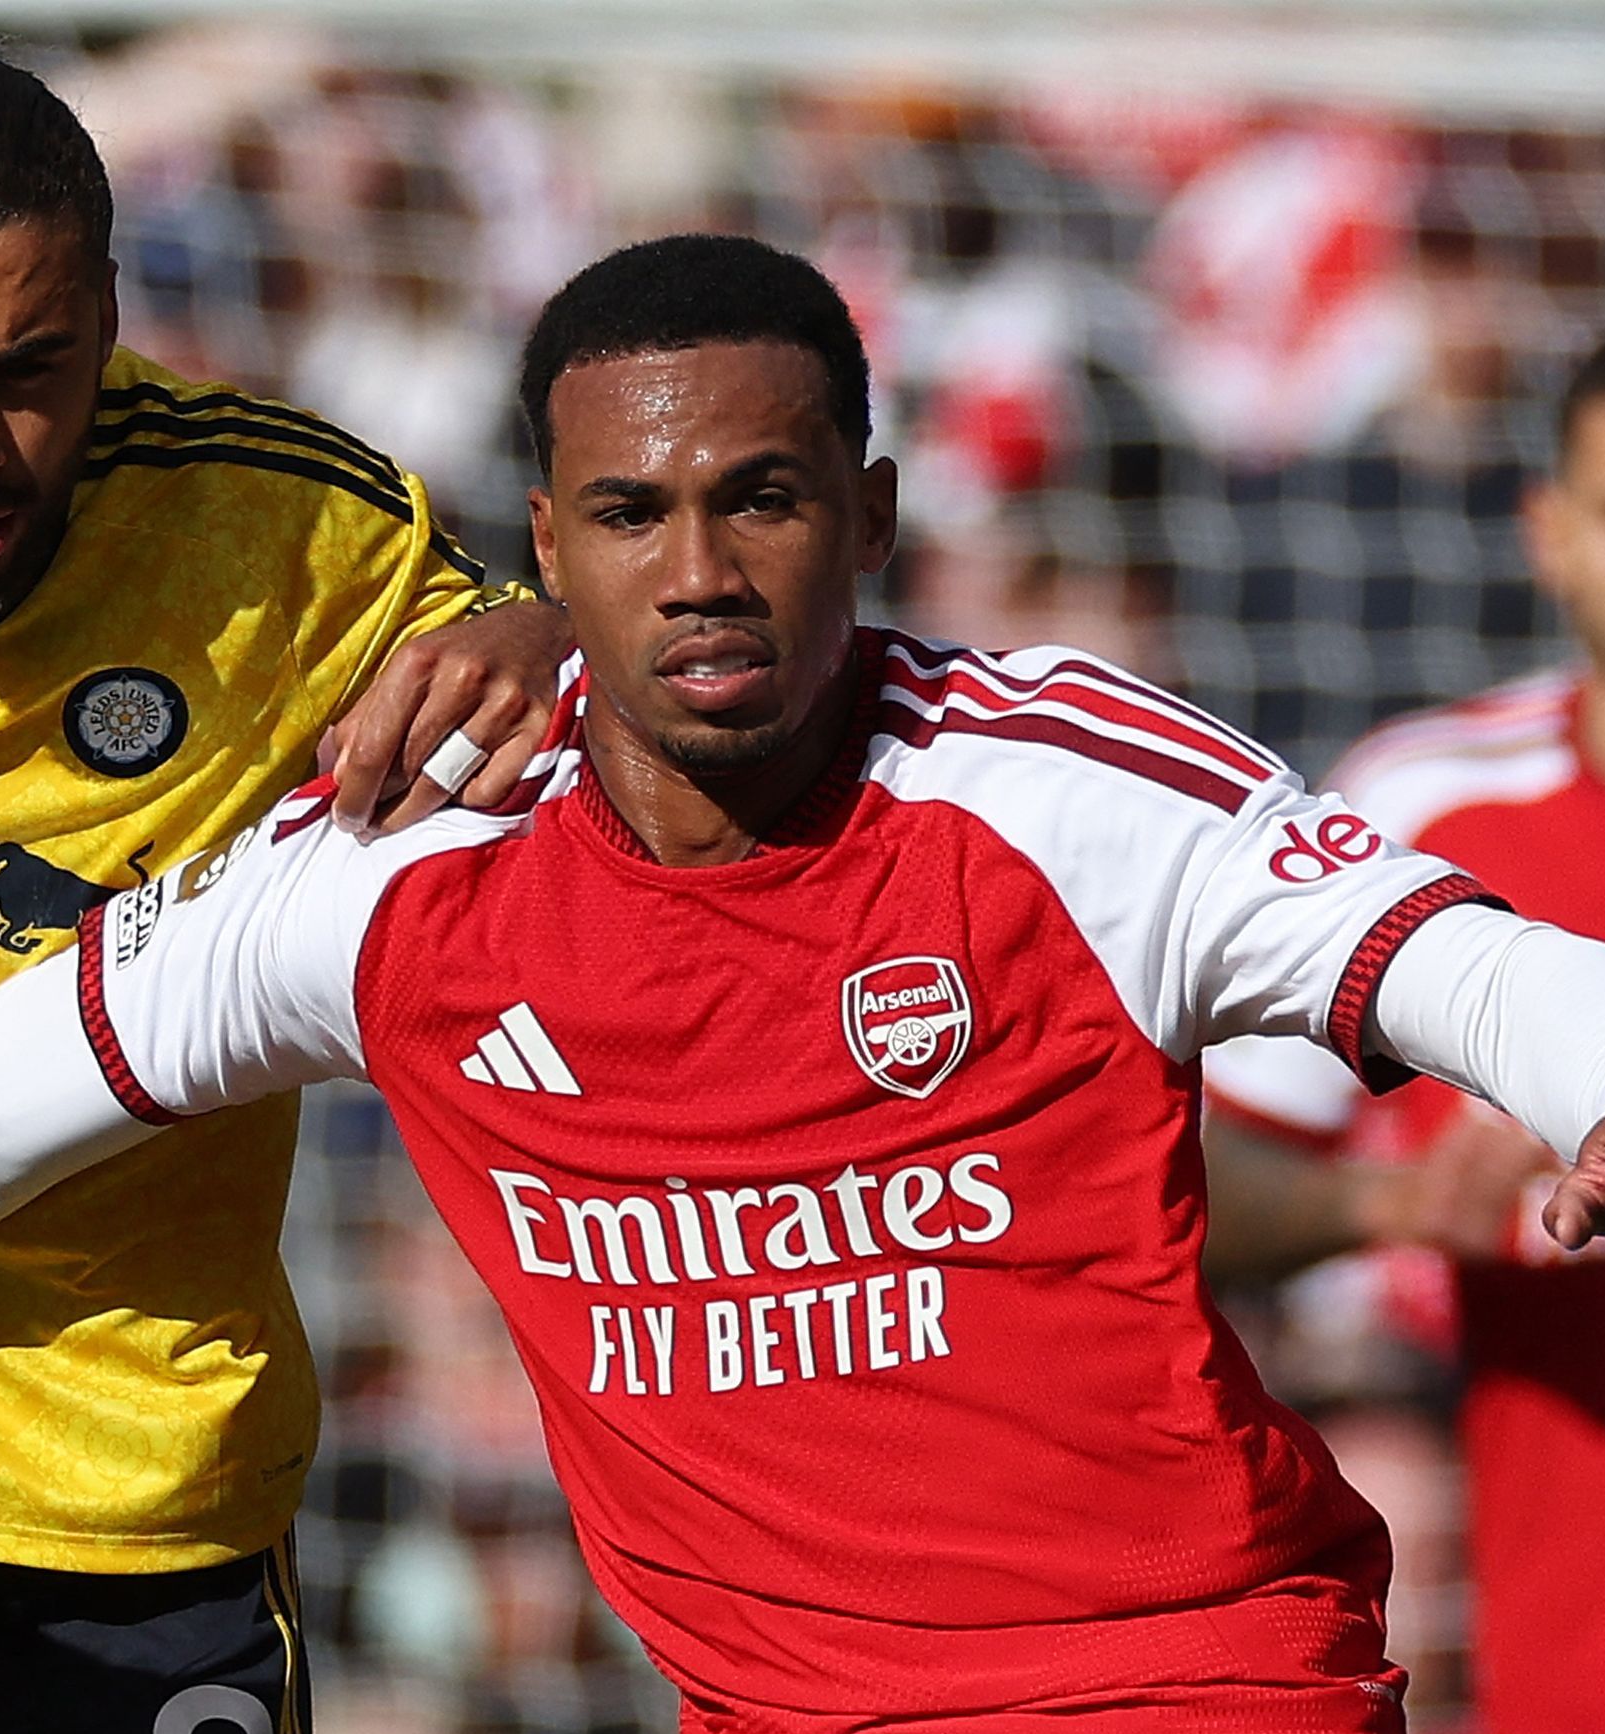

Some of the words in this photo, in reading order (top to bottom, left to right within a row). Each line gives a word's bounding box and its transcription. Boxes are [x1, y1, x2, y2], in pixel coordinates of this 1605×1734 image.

[90, 689, 121, 735] LEEDS
[128, 689, 160, 734] UNITED
[109, 737, 143, 751] AFC
[1268, 813, 1382, 883] de
[861, 978, 948, 1015] Arsenal
[488, 1153, 1013, 1285] Emirates
[588, 1305, 675, 1395] FLY
[705, 1266, 951, 1392] BETTER
